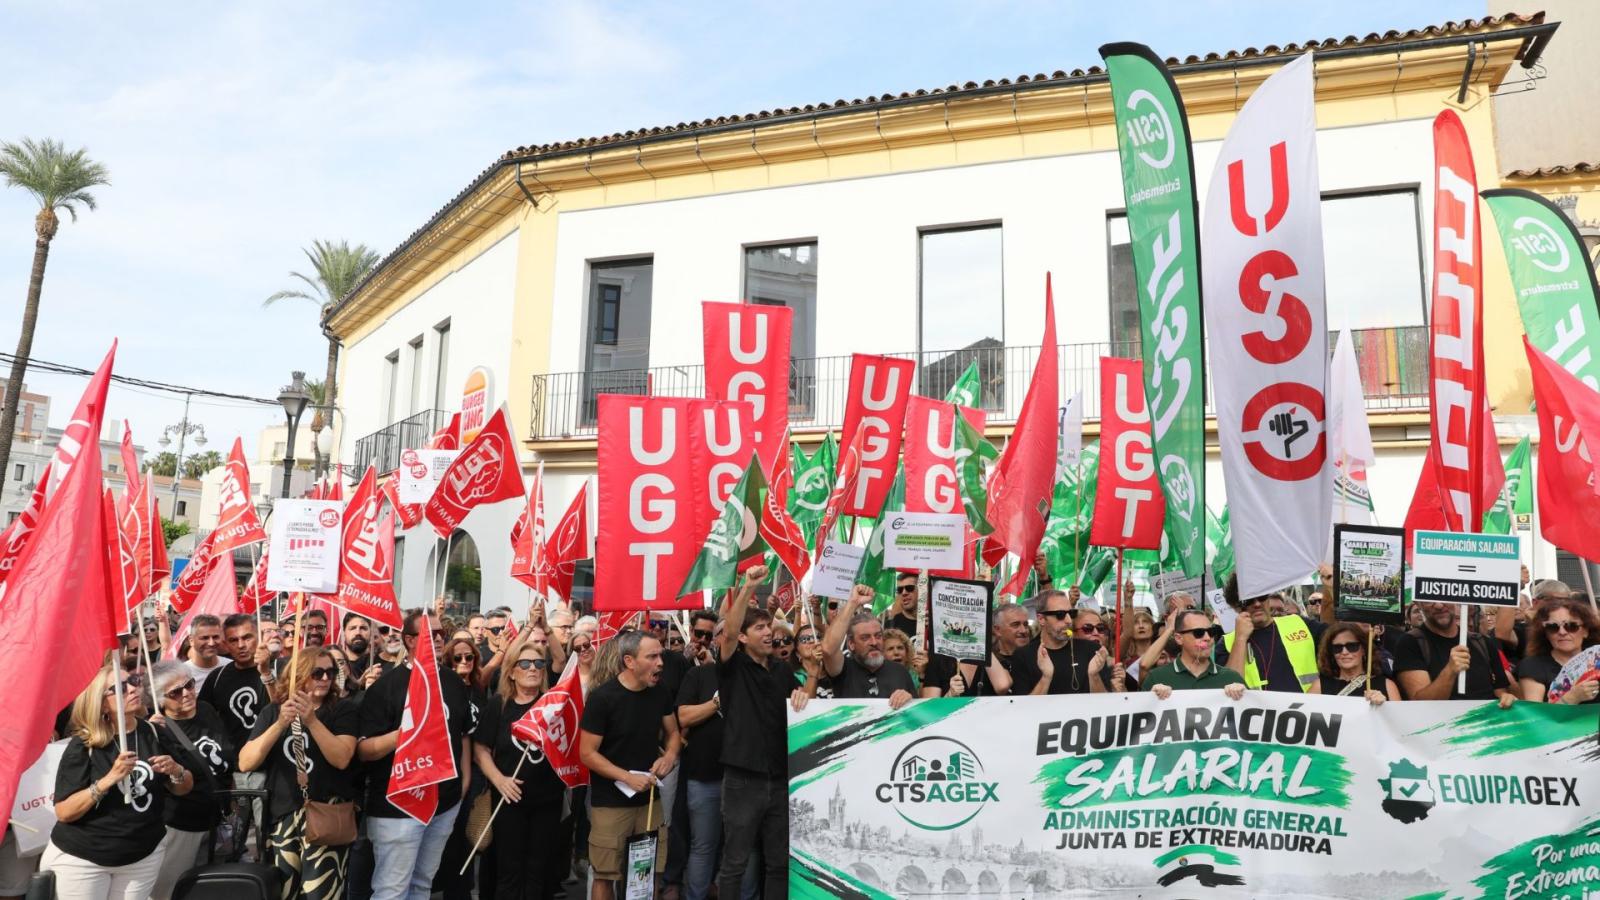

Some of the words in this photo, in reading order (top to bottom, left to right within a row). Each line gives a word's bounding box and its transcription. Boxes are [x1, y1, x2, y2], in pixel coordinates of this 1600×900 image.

[1227, 141, 1327, 481] USO
[853, 365, 900, 509] UGT
[449, 437, 501, 491] UGT
[704, 408, 744, 513] UG
[924, 408, 956, 513] UG
[1114, 374, 1153, 537] UGT
[629, 406, 676, 600] UGT
[1421, 537, 1477, 553] EQUIPARACIÓN
[1479, 541, 1515, 555] SALARIAL
[938, 593, 984, 607] CONCENTRACIÓN
[1420, 581, 1470, 597] JUSTICIA
[1473, 584, 1514, 600] SOCIAL
[1285, 629, 1308, 641] USO
[1036, 703, 1343, 756] EQUIPARACIÓN
[391, 755, 433, 779] gt.es
[1058, 749, 1323, 807] SALARIAL
[22, 796, 47, 812] UGT
[875, 781, 1000, 804] CTSAGEX
[1438, 773, 1580, 807] EQUIPAGEX
[1043, 801, 1237, 831] ADMINISTRACIÓN
[1243, 809, 1348, 837] GENERAL
[1056, 831, 1127, 850] JUNTA
[1134, 831, 1162, 849] DE
[1169, 828, 1333, 856] EXTREMADURA
[1531, 844, 1566, 868] Por
[1505, 865, 1600, 900] Extrema
